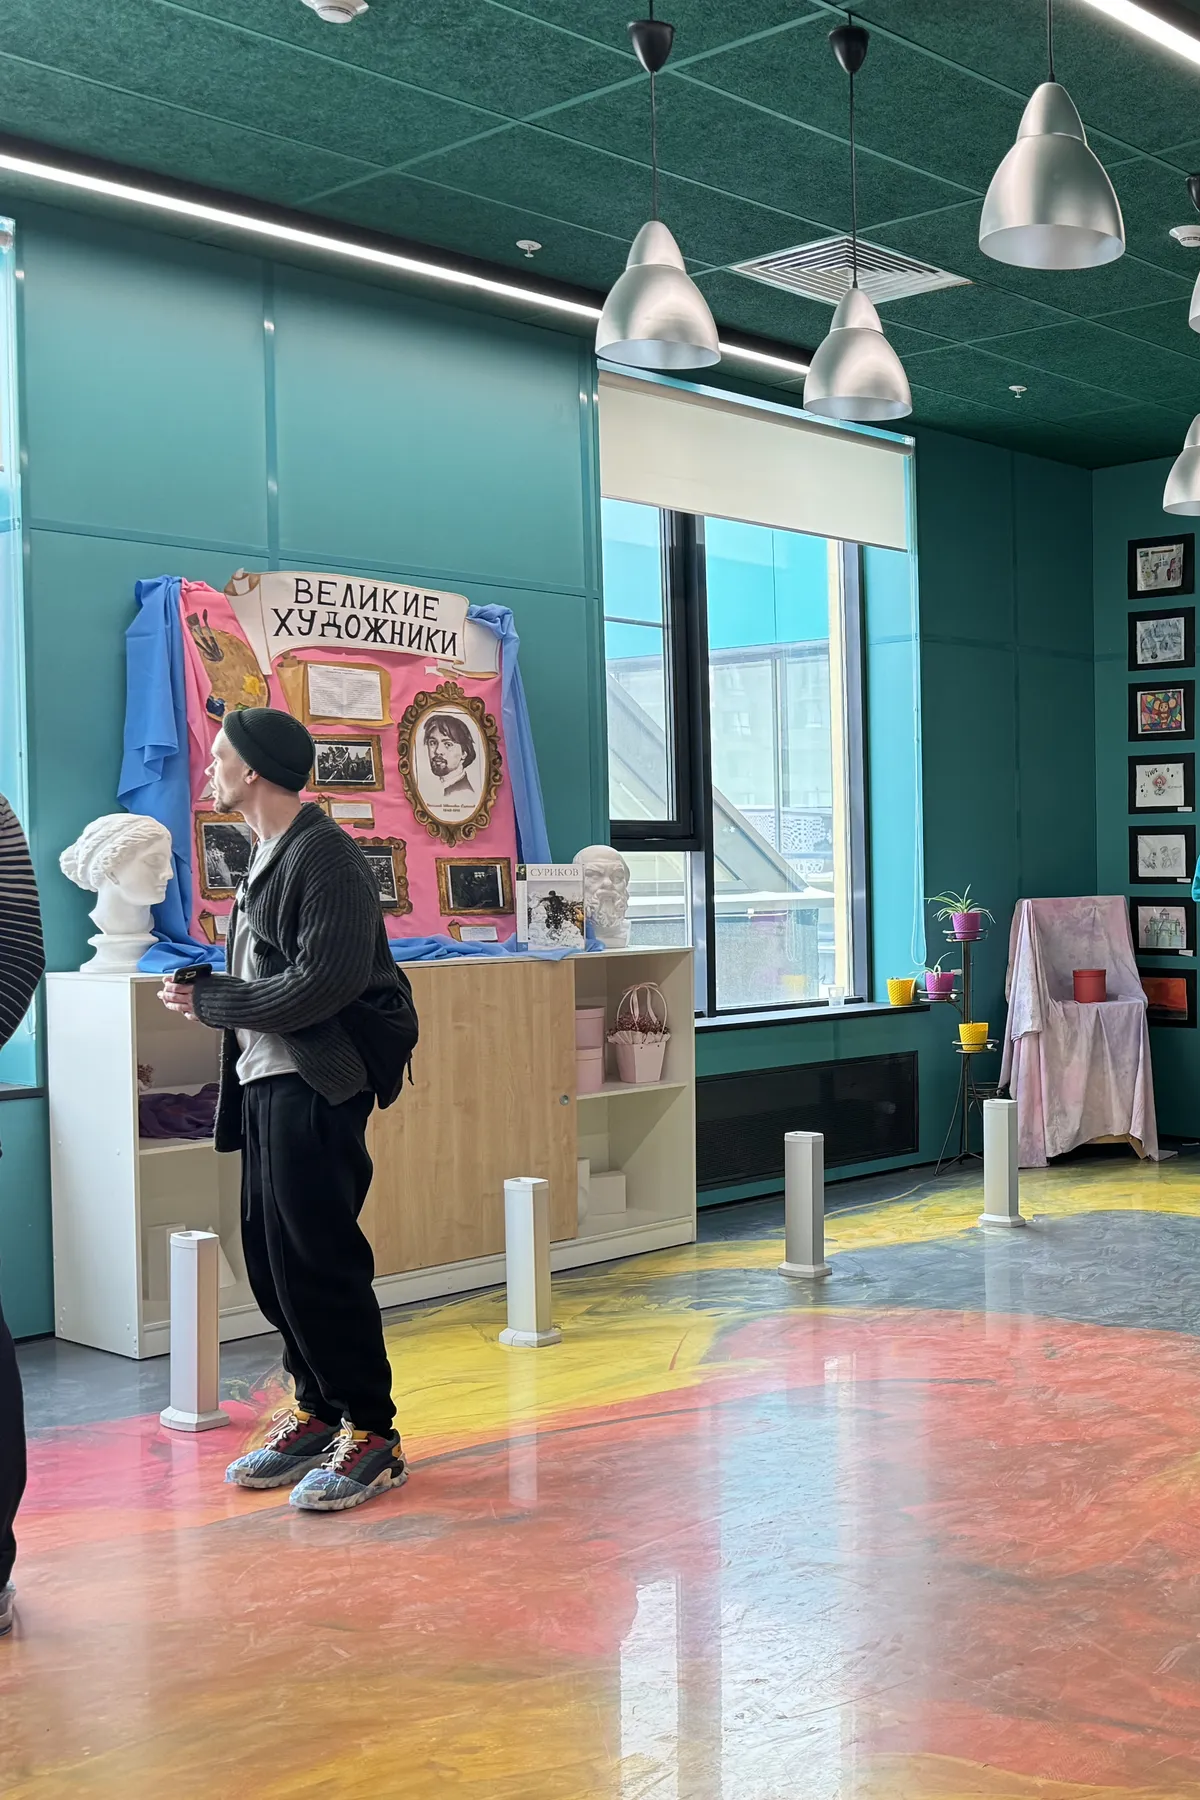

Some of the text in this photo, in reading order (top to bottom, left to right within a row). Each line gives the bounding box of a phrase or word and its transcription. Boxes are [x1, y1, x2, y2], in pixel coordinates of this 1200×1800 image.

[294, 578, 440, 621] ВЕЛИКИЕ
[271, 608, 457, 656] ХУДОЖНИКИ
[530, 868, 579, 877] СУРИКОВ
